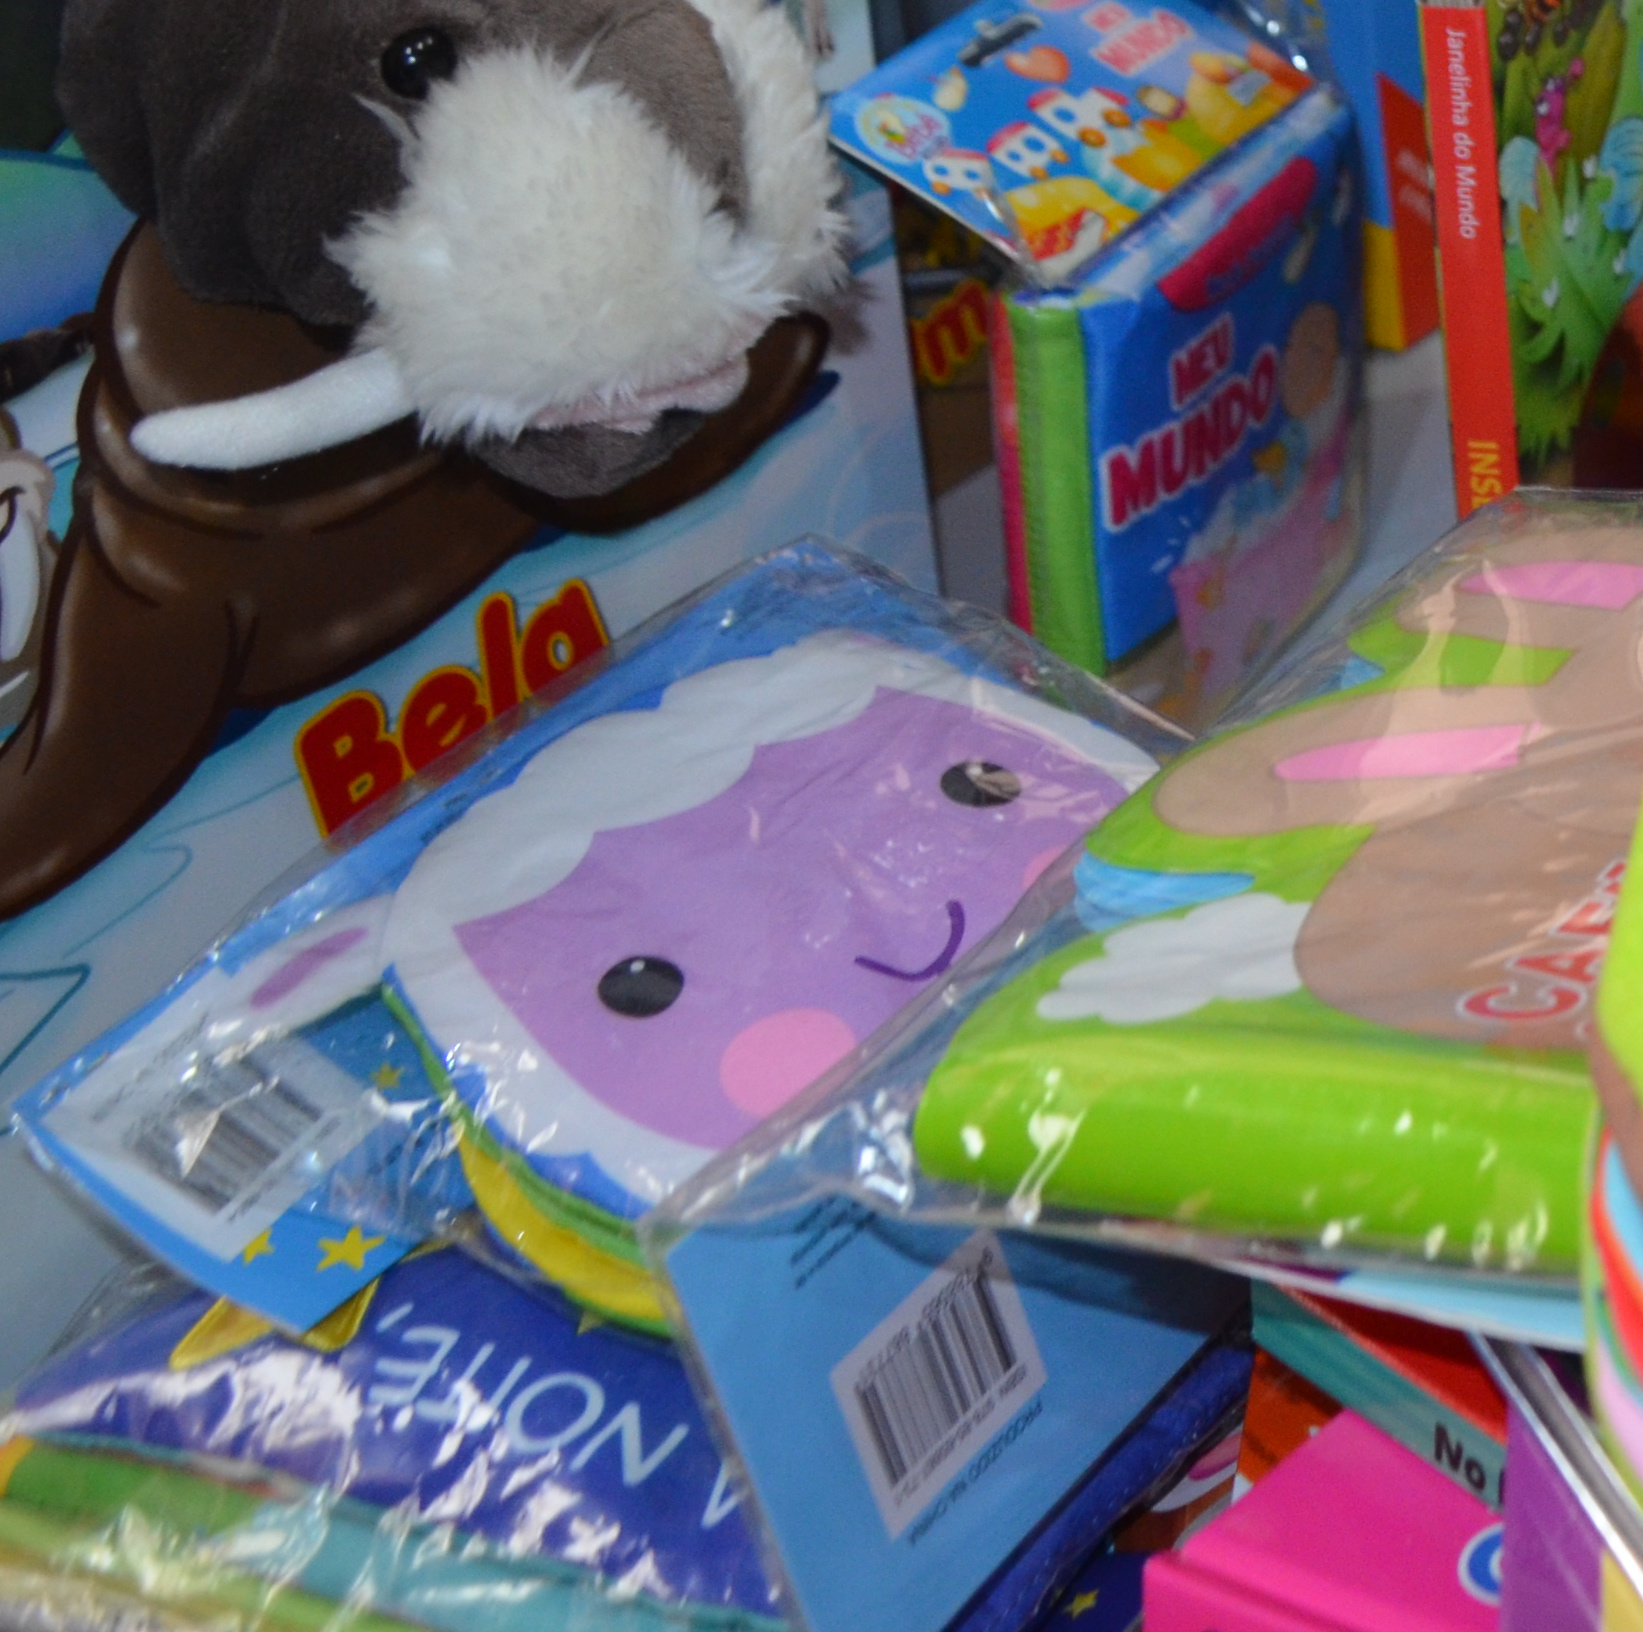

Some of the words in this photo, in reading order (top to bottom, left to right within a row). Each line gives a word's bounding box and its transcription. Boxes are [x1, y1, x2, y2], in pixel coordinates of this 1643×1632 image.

[1445, 27, 1474, 127] Janelinha
[1452, 131, 1476, 160] do
[1456, 164, 1482, 241] Mundo
[1101, 344, 1279, 533] MUNDO
[291, 576, 611, 852] Bela
[368, 1303, 689, 1488] NOITE,
[967, 1397, 1044, 1480] PRODUZIDO
[1434, 1420, 1487, 1491] No
